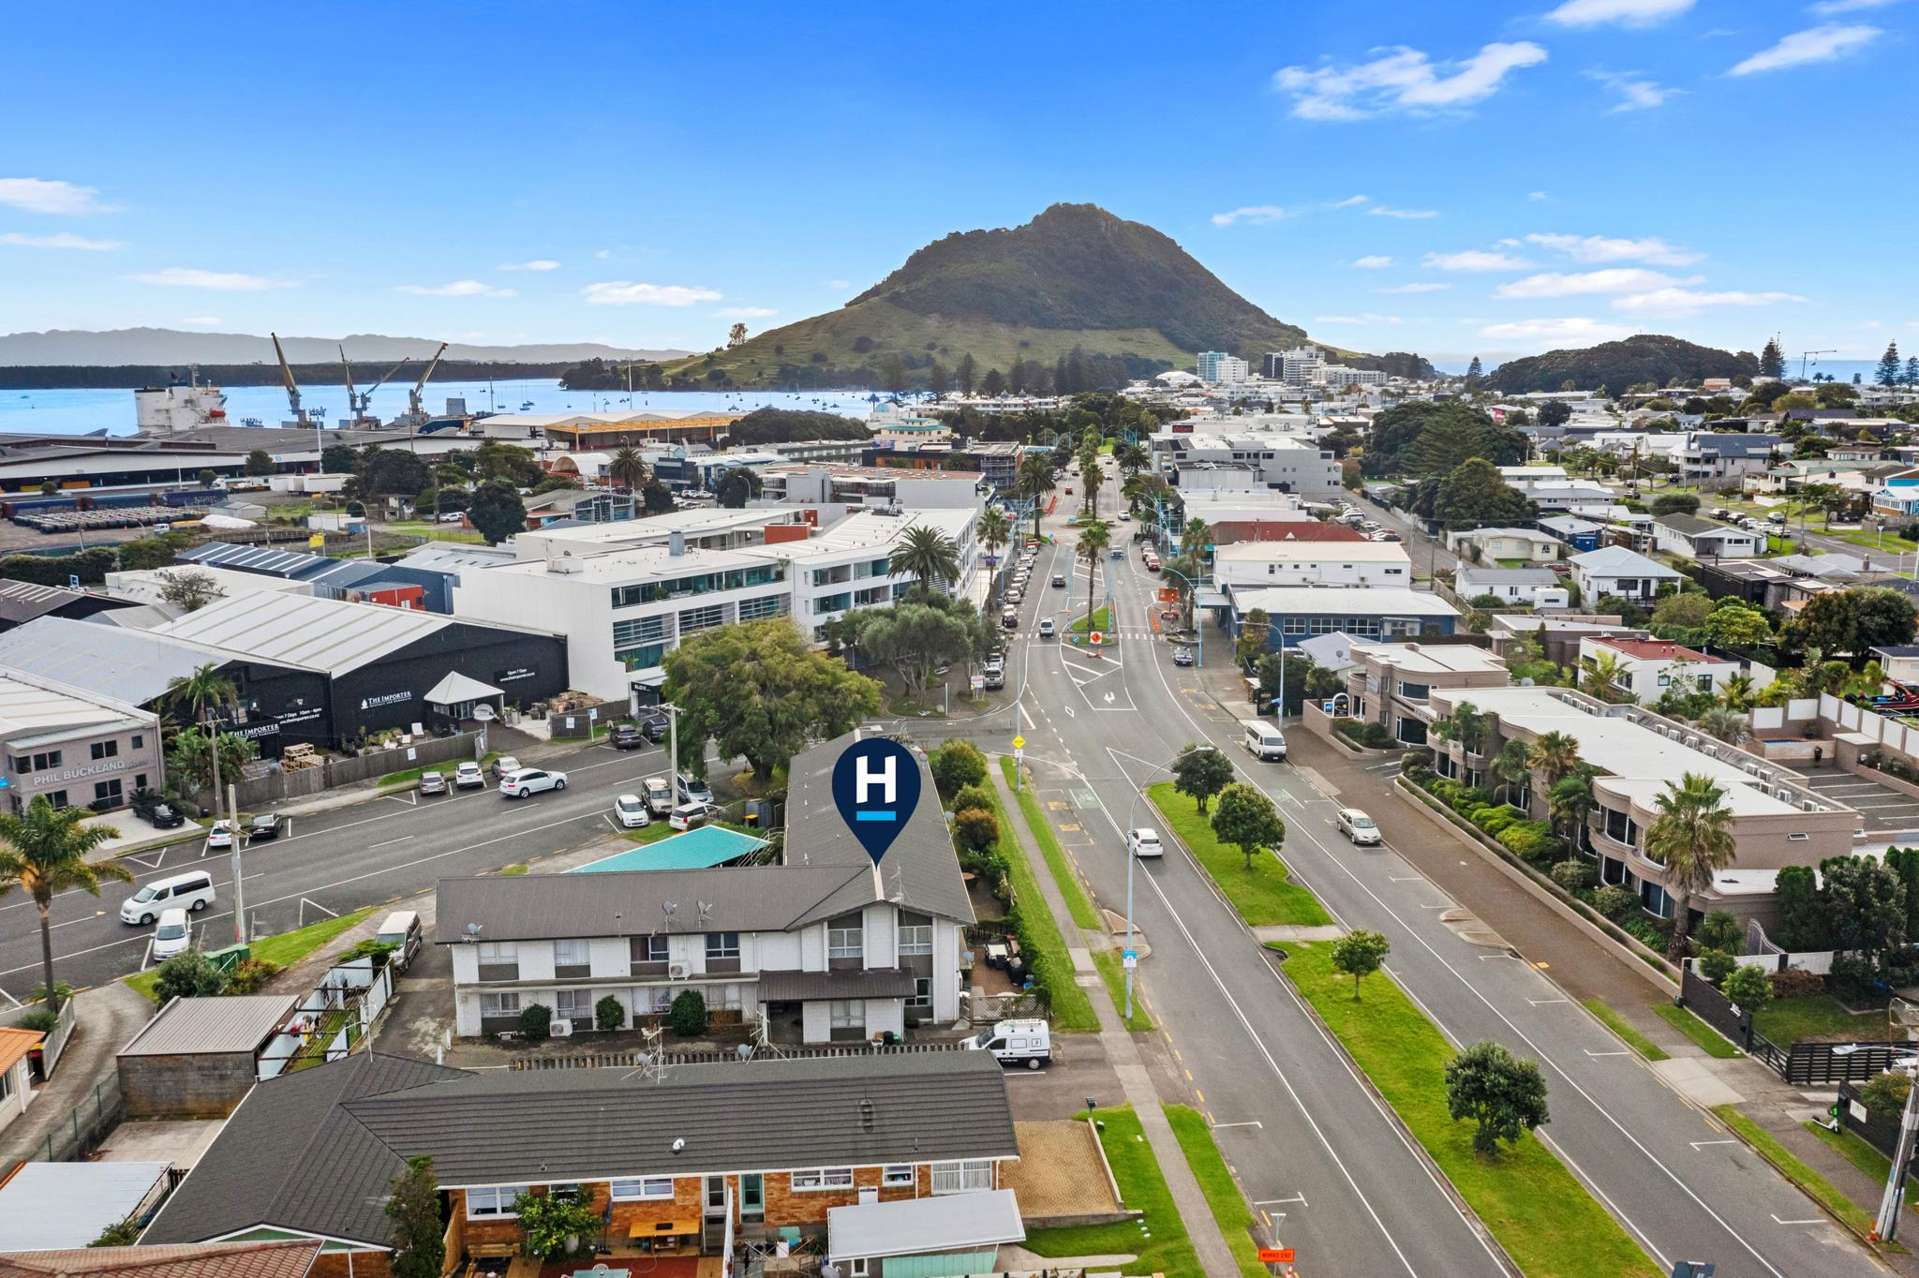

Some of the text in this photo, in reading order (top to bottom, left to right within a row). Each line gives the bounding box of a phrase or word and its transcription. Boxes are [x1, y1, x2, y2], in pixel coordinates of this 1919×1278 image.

[244, 723, 280, 736] IMPORTER
[33, 773, 61, 786] PHIL
[63, 760, 126, 780] BUCKLAND
